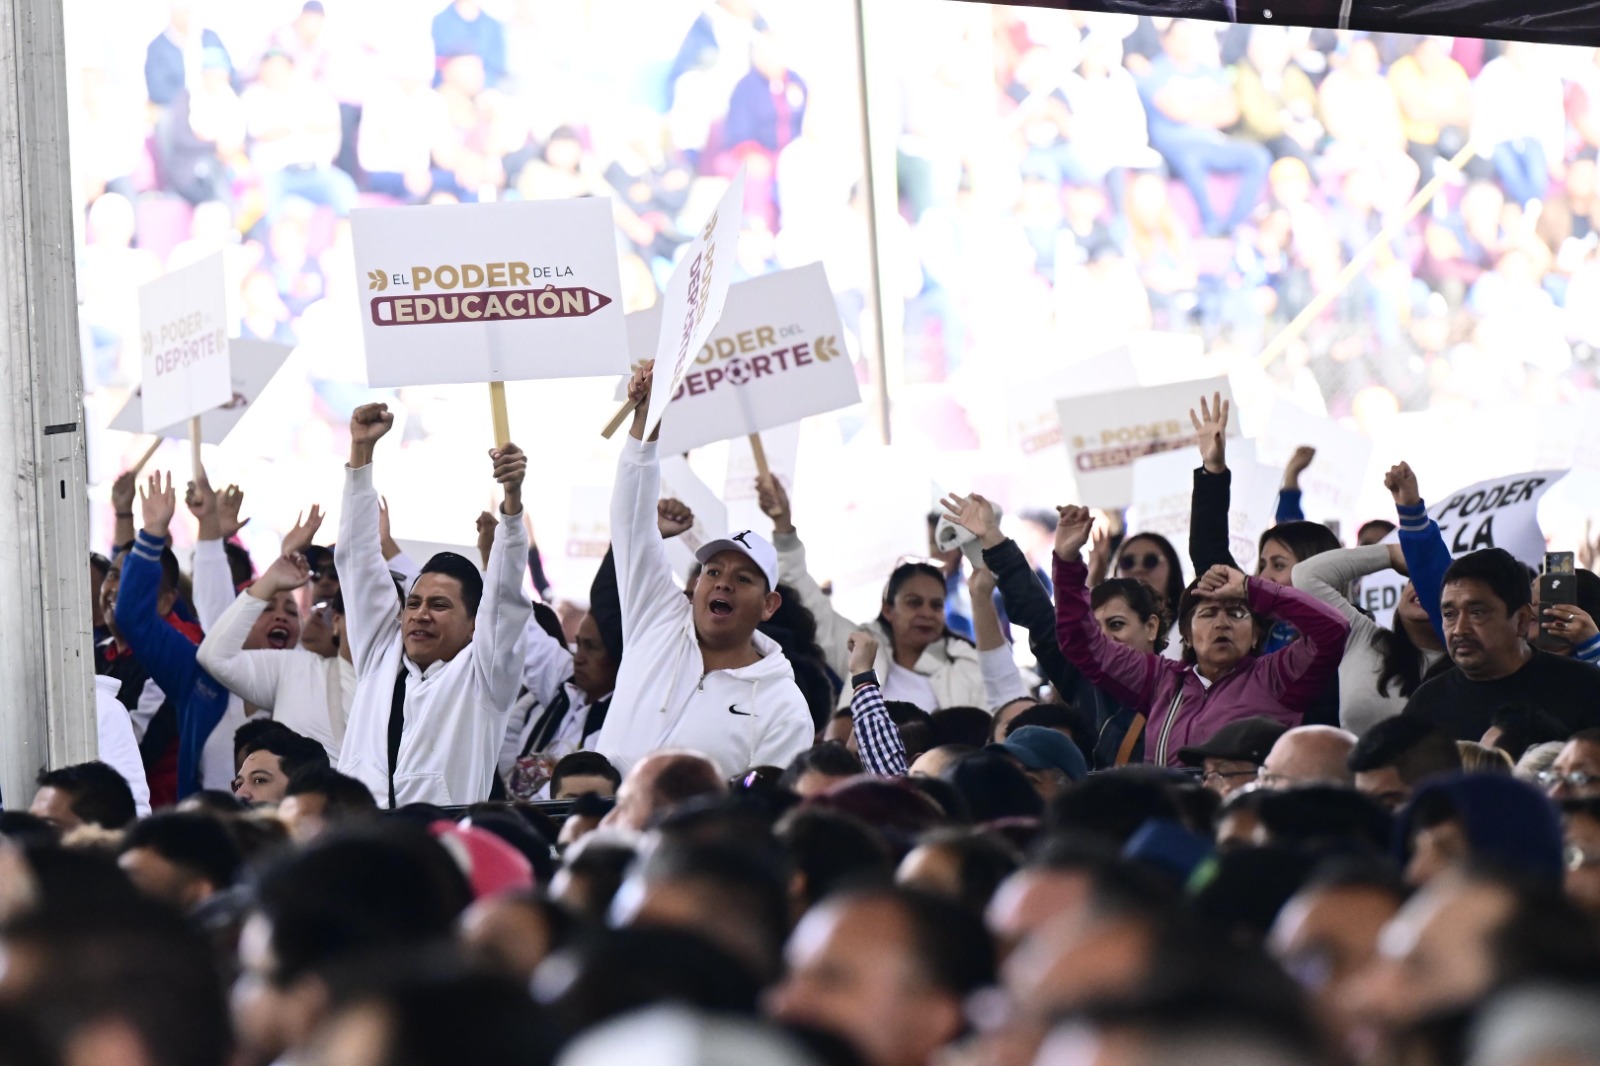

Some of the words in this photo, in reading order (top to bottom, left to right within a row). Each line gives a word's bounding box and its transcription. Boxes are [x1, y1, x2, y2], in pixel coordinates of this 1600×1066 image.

[392, 273, 409, 285] EL
[411, 261, 531, 291] PODER
[533, 267, 551, 278] DE
[556, 265, 574, 277] LA
[394, 284, 585, 322] EDUCACIÓN
[160, 310, 202, 346] PODER
[694, 325, 777, 365] ODER
[779, 324, 804, 338] DEL
[155, 332, 214, 377] DEPORTE
[1437, 478, 1547, 520] PODER
[1452, 515, 1495, 554] LA
